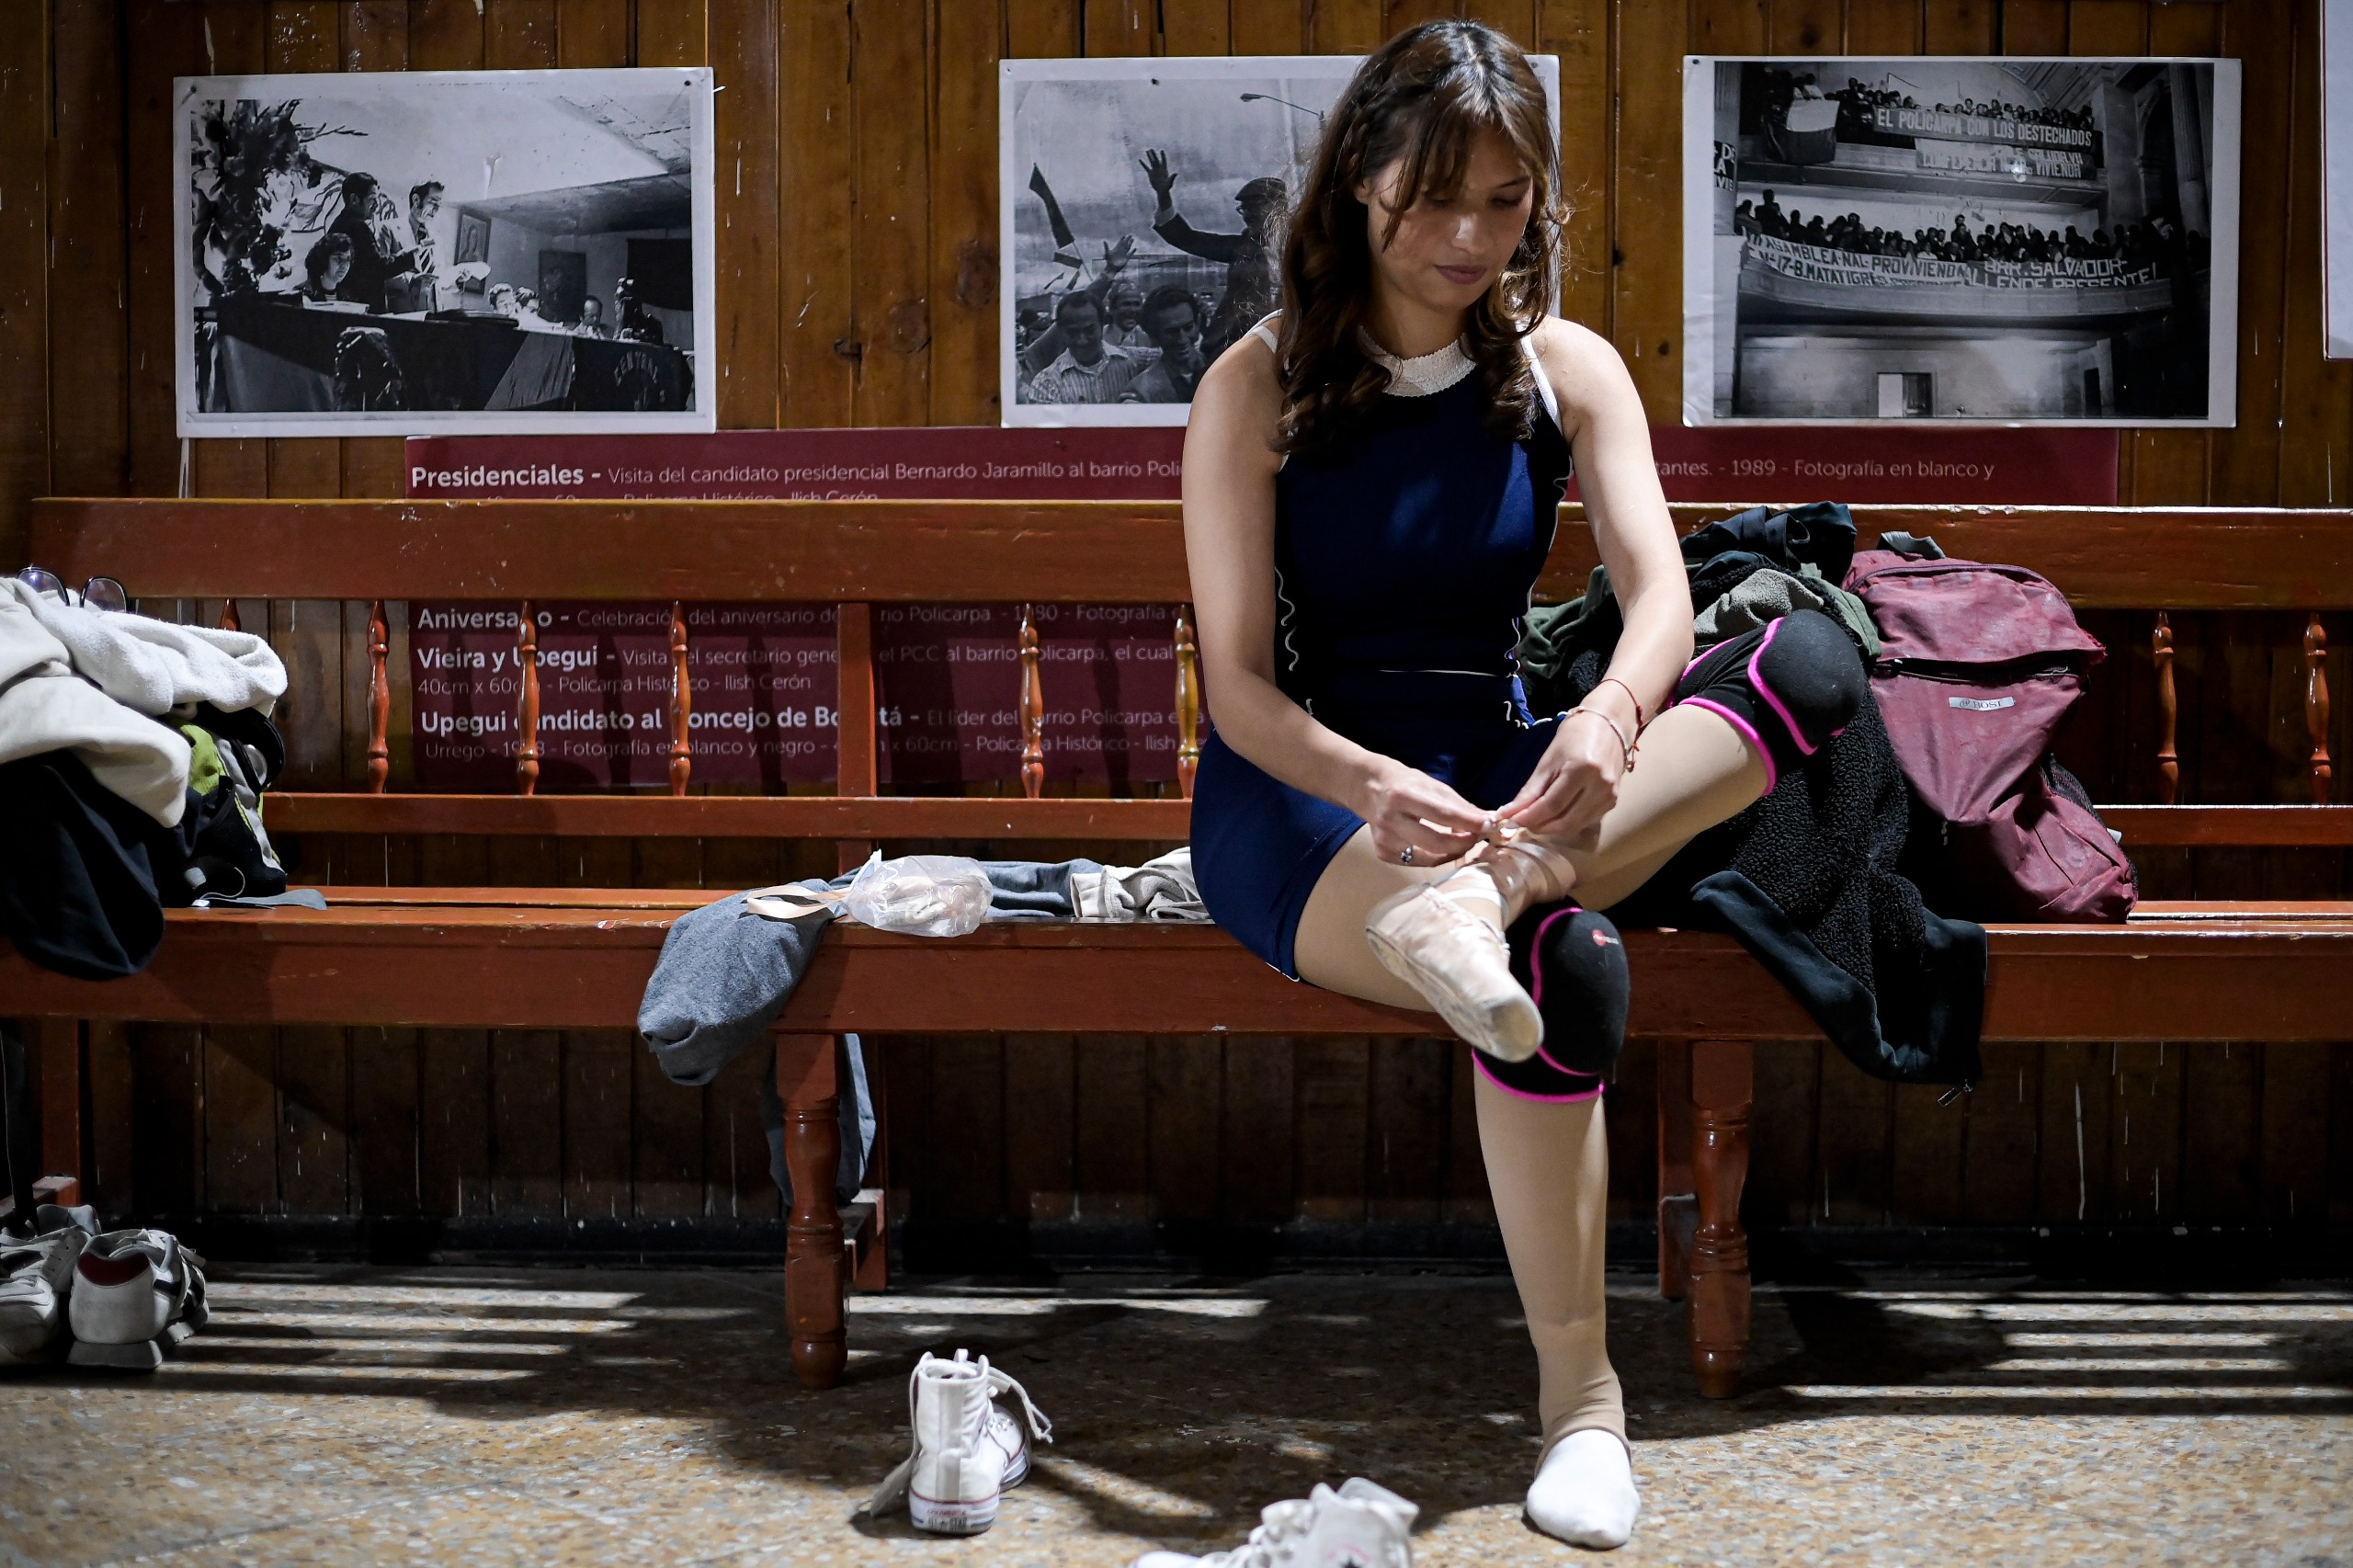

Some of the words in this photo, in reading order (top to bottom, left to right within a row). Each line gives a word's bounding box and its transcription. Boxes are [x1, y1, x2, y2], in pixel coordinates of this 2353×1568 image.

[1878, 108, 1893, 128] EL
[1993, 119, 2015, 139] LOS
[2018, 122, 2093, 147] DESTECHADOS
[412, 463, 585, 488] Presidenciales
[608, 467, 654, 484] Visita
[658, 466, 686, 483] del
[690, 465, 779, 483] candidato
[784, 463, 890, 485] presidencial
[895, 462, 977, 480] Bernardo
[982, 461, 1064, 479] Jaramillo
[1068, 461, 1085, 478] al
[1089, 460, 1142, 478] barrio
[1732, 459, 1776, 477] 1989
[1794, 459, 1884, 481] Fotografía
[1889, 463, 1913, 477] en
[1917, 460, 1979, 478] blanco
[1984, 463, 1995, 482] y
[417, 608, 552, 631] Aniversao
[577, 608, 671, 627] Celebració
[689, 608, 715, 625] del
[721, 608, 814, 625] aniversario
[910, 606, 992, 626] Policarpa
[1014, 605, 1058, 621] 180
[1075, 604, 1166, 625] Fotografía
[417, 646, 485, 670] Vieira
[492, 650, 506, 674] y
[622, 648, 668, 667] Visita
[705, 649, 792, 665] secretario
[879, 646, 894, 663] el
[901, 645, 942, 663] PCC
[946, 645, 961, 663] al
[966, 645, 1017, 663] barrio
[1039, 644, 1110, 664] olicarpa,
[1115, 644, 1131, 661] el
[1136, 644, 1173, 660] cual
[417, 677, 470, 696] 40cm
[475, 682, 484, 695] x
[489, 676, 540, 695] 60c
[559, 676, 632, 696] Policarpa
[637, 675, 710, 692] Histco
[759, 673, 812, 690] Cerón
[1972, 700, 2002, 710] BOSI
[421, 710, 506, 738] Upegui
[513, 708, 635, 732] ndidato
[641, 707, 663, 731] al
[688, 707, 771, 734] oncejo
[777, 706, 807, 729] de
[814, 705, 903, 729] Botá
[927, 710, 943, 726] El
[949, 709, 986, 726] líder
[991, 709, 1018, 725] del
[1042, 709, 1075, 725] rrio
[1081, 708, 1163, 727] Policarpa
[426, 742, 485, 763] Urrego
[563, 739, 651, 761] Fotografía
[748, 742, 757, 759] y
[764, 741, 816, 759] negro
[905, 735, 958, 753] 60cm
[976, 735, 1051, 753] Policaa
[1056, 734, 1130, 752] Histórico
